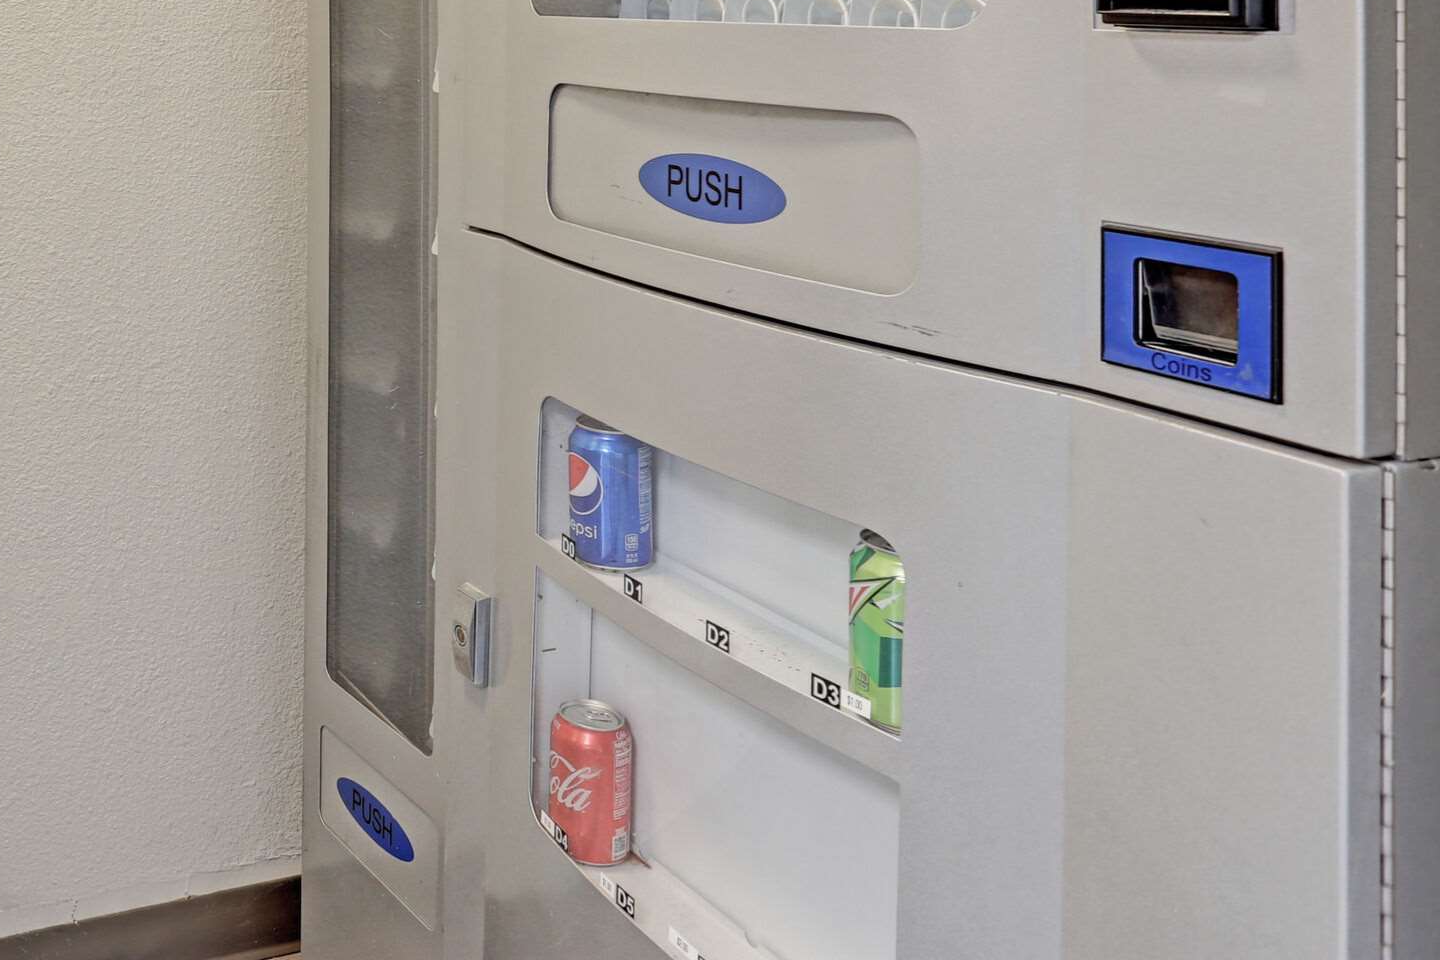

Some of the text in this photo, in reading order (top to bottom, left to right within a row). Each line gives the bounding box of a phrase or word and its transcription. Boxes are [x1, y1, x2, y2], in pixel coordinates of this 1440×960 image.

[667, 164, 743, 210] PUSH
[1151, 352, 1212, 381] Coins
[563, 537, 575, 558] D0
[625, 576, 642, 602] D1
[706, 623, 729, 651] D2
[813, 676, 840, 706] D3
[351, 788, 393, 847] PUSH
[556, 825, 568, 850] D4
[618, 887, 635, 916] D5
